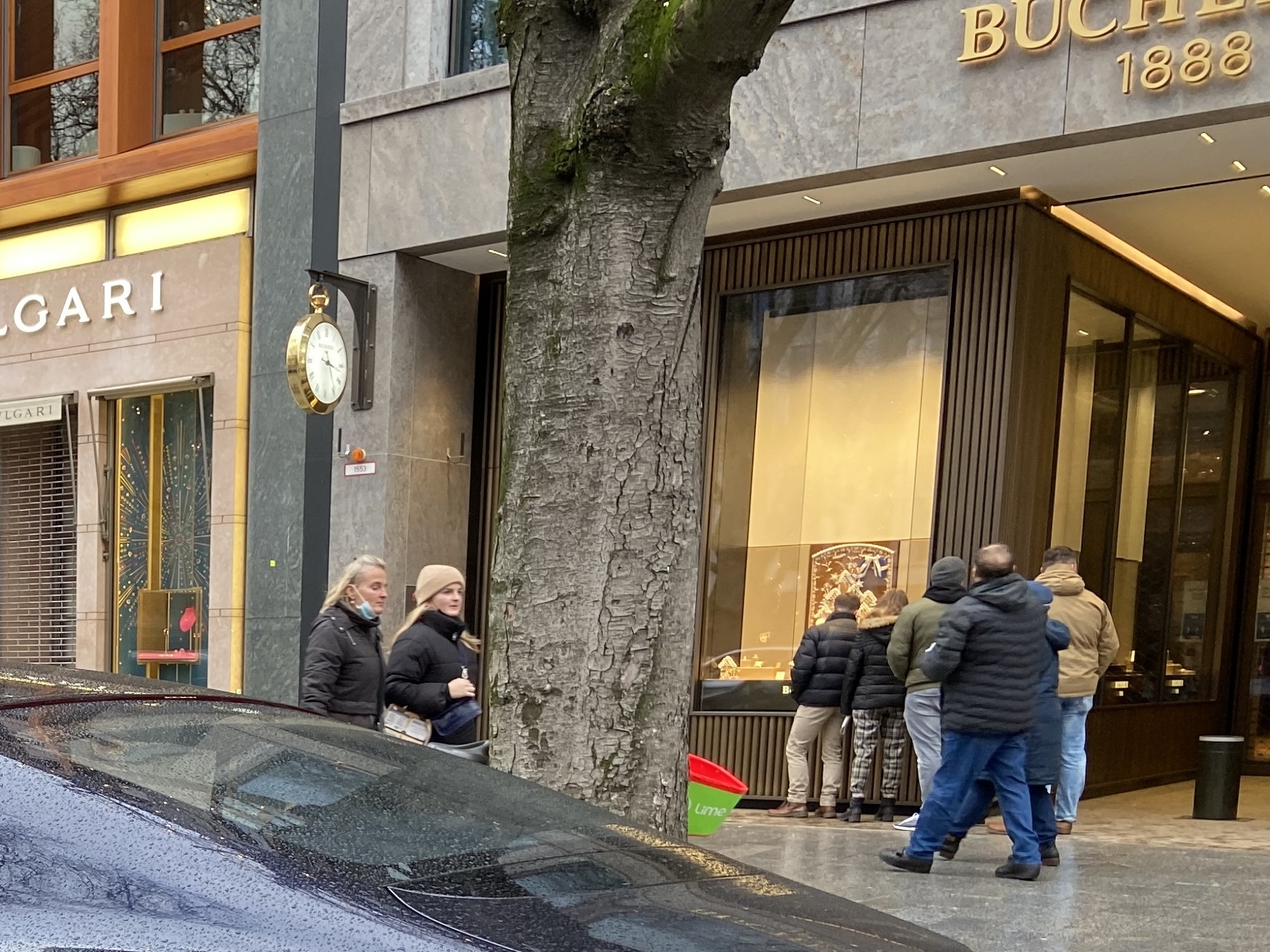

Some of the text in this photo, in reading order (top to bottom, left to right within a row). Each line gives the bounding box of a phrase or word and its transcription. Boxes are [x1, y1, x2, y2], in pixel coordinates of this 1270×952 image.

[957, 0, 1270, 62] BUCH
[1117, 31, 1252, 95] 1888
[695, 803, 727, 817] Lime
